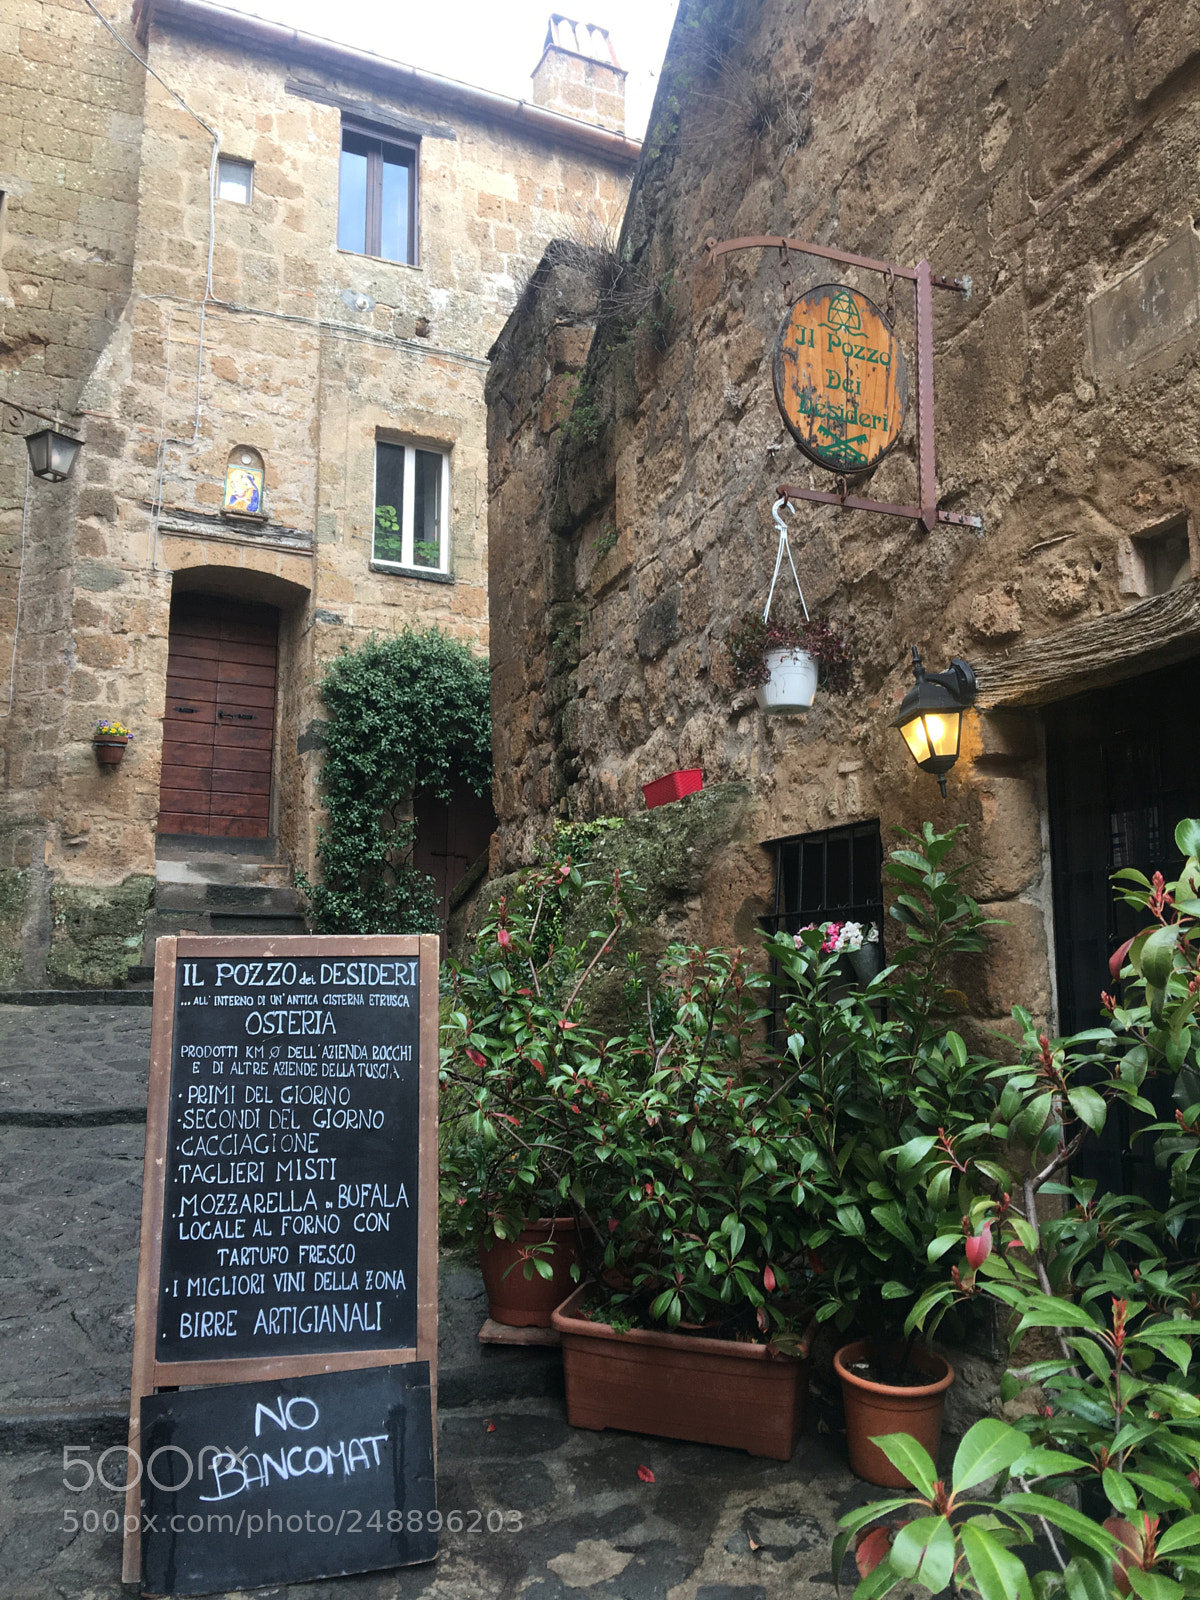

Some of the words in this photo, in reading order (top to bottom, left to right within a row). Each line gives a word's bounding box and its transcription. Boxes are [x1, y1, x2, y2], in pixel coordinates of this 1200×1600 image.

[827, 332, 891, 366] Pozzo
[825, 368, 861, 396] Dei
[796, 393, 888, 431] Desideri
[183, 963, 204, 986] IL
[215, 962, 297, 986] POZZO
[299, 971, 316, 985] dei
[320, 962, 418, 986] DESIDERI
[214, 996, 254, 1007] INTERNO
[257, 996, 266, 1005] DI
[323, 994, 365, 1005] CISTERNA
[369, 994, 410, 1007] ETRUSCA
[245, 1010, 336, 1035] OSTERIA
[180, 1045, 238, 1059] PRODOTTI
[246, 1045, 264, 1057] KM
[372, 1045, 412, 1062] ROCCHI
[193, 1062, 200, 1074] E
[213, 1062, 223, 1074] DI
[230, 1062, 268, 1075] ALTRE
[273, 1062, 317, 1076] AZIENDE
[322, 1063, 355, 1077] DELLA
[187, 1085, 234, 1104] PRIMI
[245, 1086, 273, 1103] DEL
[281, 1086, 350, 1105] GIORNO
[182, 1109, 260, 1129] SECONDI
[269, 1109, 300, 1129] DEL
[313, 1109, 384, 1129] GIORNO
[181, 1133, 319, 1156] CACCIAGIONE
[178, 1162, 264, 1183] TAGLIERI
[276, 1158, 336, 1182] MISTI
[179, 1189, 318, 1217] MOZZARELLA
[338, 1183, 409, 1209] BUFALA
[179, 1219, 245, 1240] LOCALE
[253, 1219, 272, 1237] AL
[281, 1214, 340, 1236] FORNO
[354, 1213, 390, 1232] CON
[217, 1246, 289, 1266] TARTUFO
[299, 1244, 355, 1265] FRESCO
[173, 1280, 178, 1297] I
[187, 1274, 264, 1297] MIGLIORI
[273, 1272, 305, 1292] VINI
[314, 1271, 358, 1291] DELLA
[365, 1270, 406, 1290] ZONA
[180, 1310, 237, 1338] BIRRE
[253, 1302, 382, 1335] ARTIGIANALI
[254, 1397, 319, 1437] NO
[199, 1434, 388, 1501] BANCOMAT
